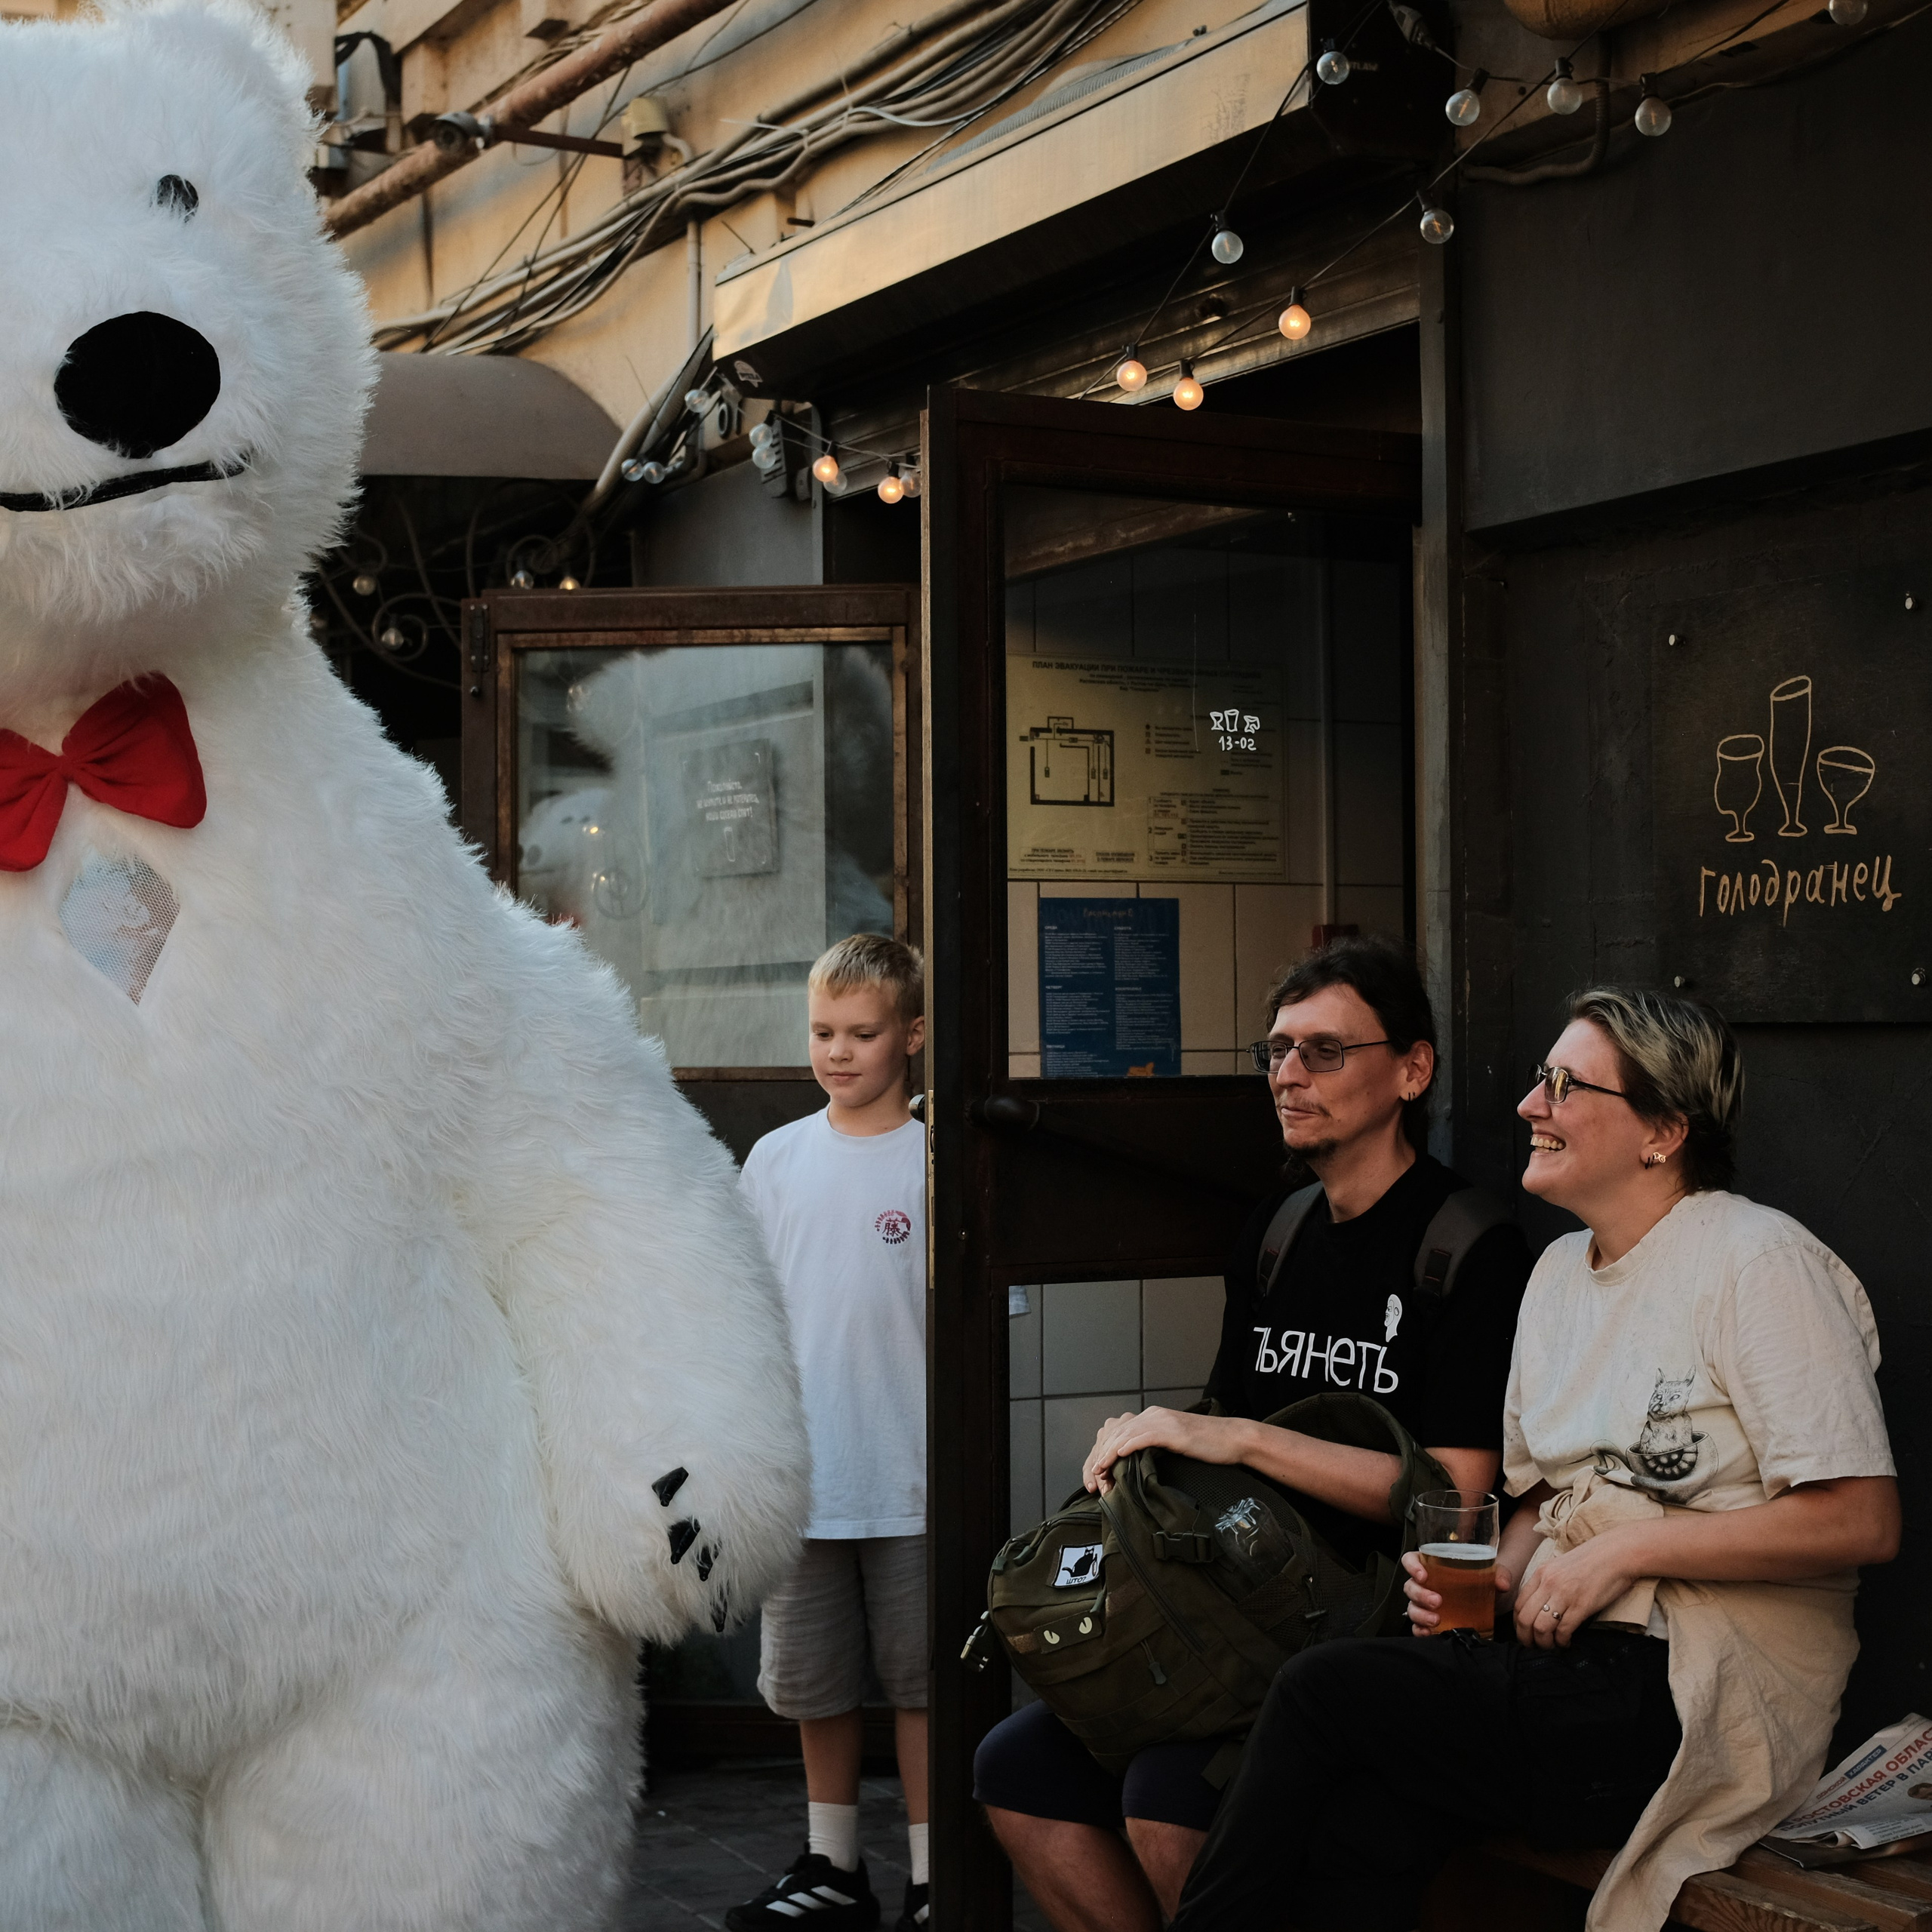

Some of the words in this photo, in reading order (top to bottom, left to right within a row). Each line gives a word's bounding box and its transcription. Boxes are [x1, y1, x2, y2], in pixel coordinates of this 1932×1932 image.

[1032, 660, 1054, 669] ПЛАН
[1054, 662, 1100, 672] ЭВАКУАЦИИ
[1100, 664, 1117, 672] ПРИ
[1117, 665, 1149, 674] ПОЖАРЕ
[1218, 735, 1257, 752] 13-02
[1848, 1748, 1882, 1777] ХАРАКТЕР
[1780, 1804, 1859, 1832] ПОПУТНЫЙ
[1856, 1780, 1897, 1806] ВЕТЕР
[1896, 1773, 1909, 1782] В
[1906, 1747, 1932, 1775] ПАР
